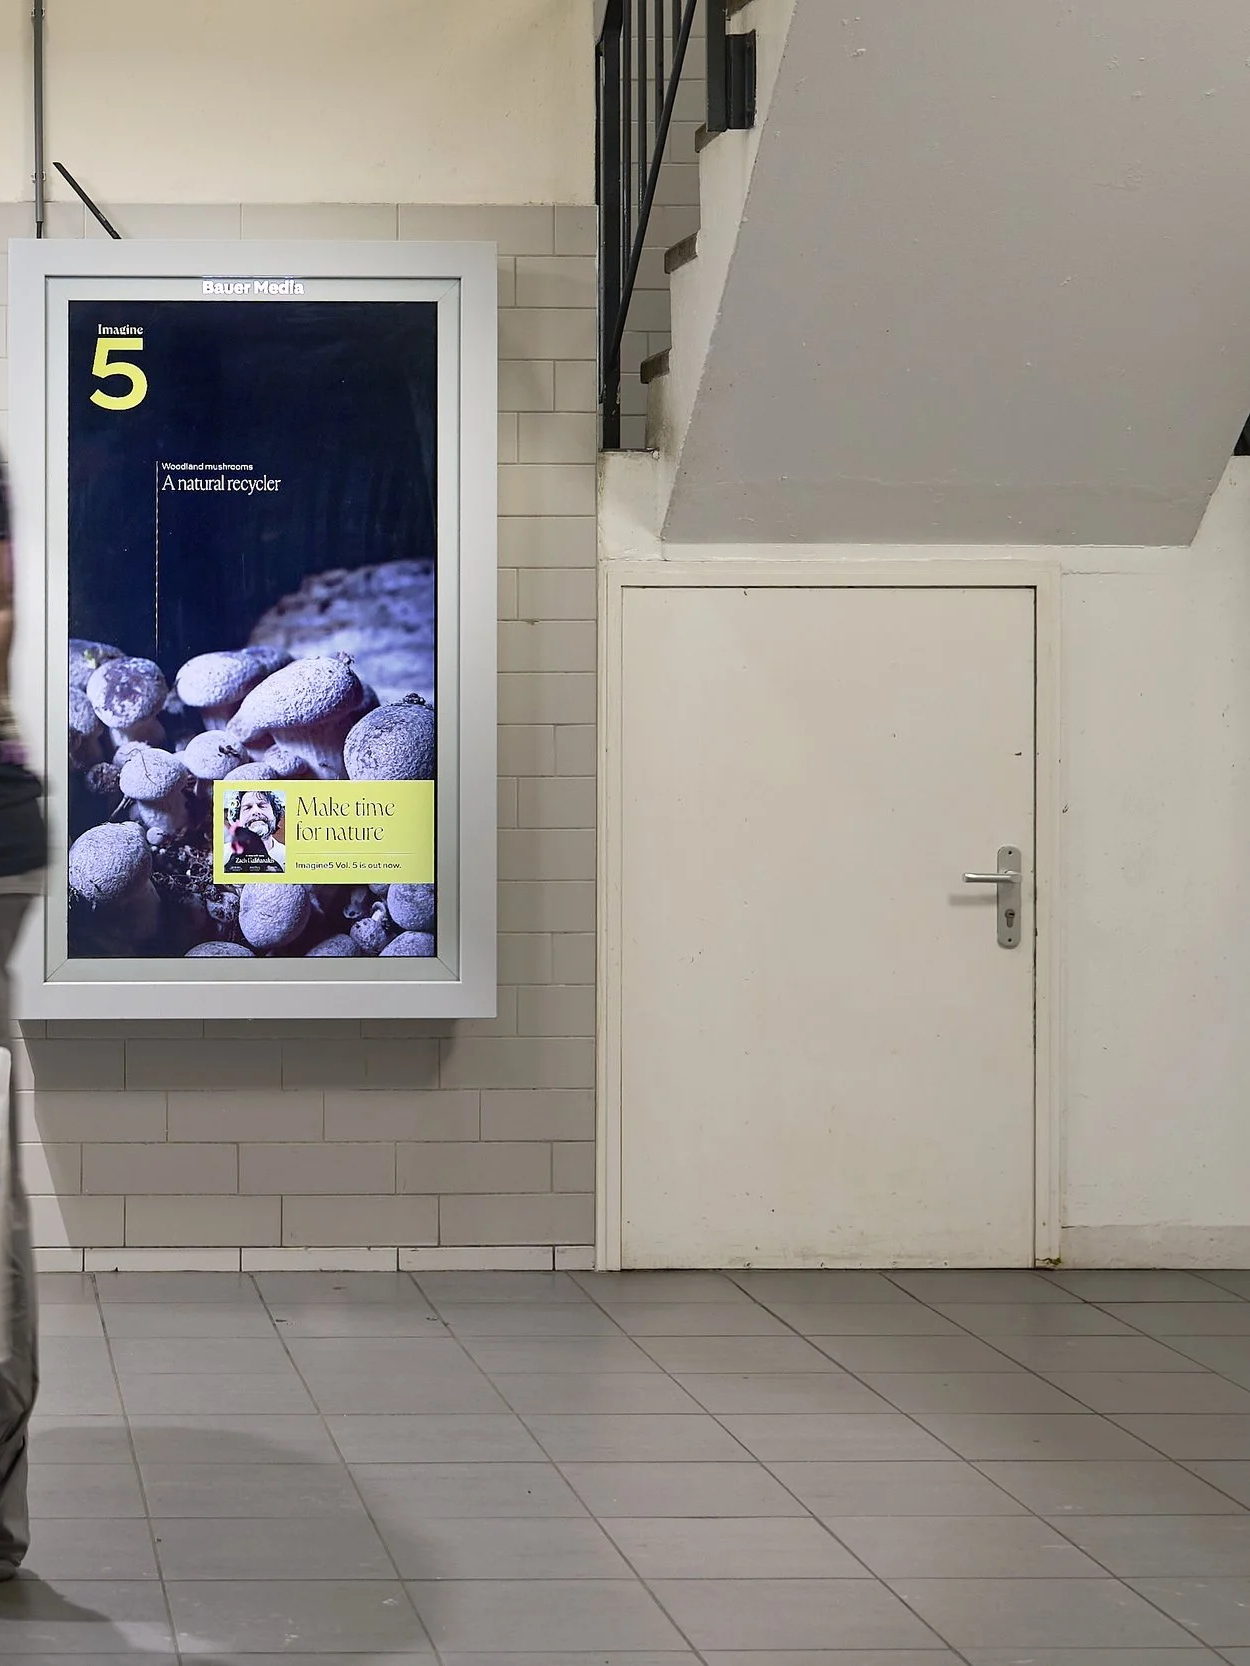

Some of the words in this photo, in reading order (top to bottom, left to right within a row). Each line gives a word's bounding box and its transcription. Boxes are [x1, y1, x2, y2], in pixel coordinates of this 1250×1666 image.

[202, 280, 250, 295] Bauer
[253, 280, 305, 295] Media
[97, 323, 144, 336] Imagine
[89, 337, 148, 410] 5
[161, 462, 204, 471] Woodland
[204, 462, 254, 471] mushrooms
[161, 474, 176, 491] A
[177, 474, 225, 491] natural
[227, 474, 282, 496] recycler
[296, 796, 350, 817] Make
[355, 797, 396, 817] time
[295, 820, 322, 841] for
[325, 826, 385, 841] nature
[295, 862, 334, 870] Imagine5
